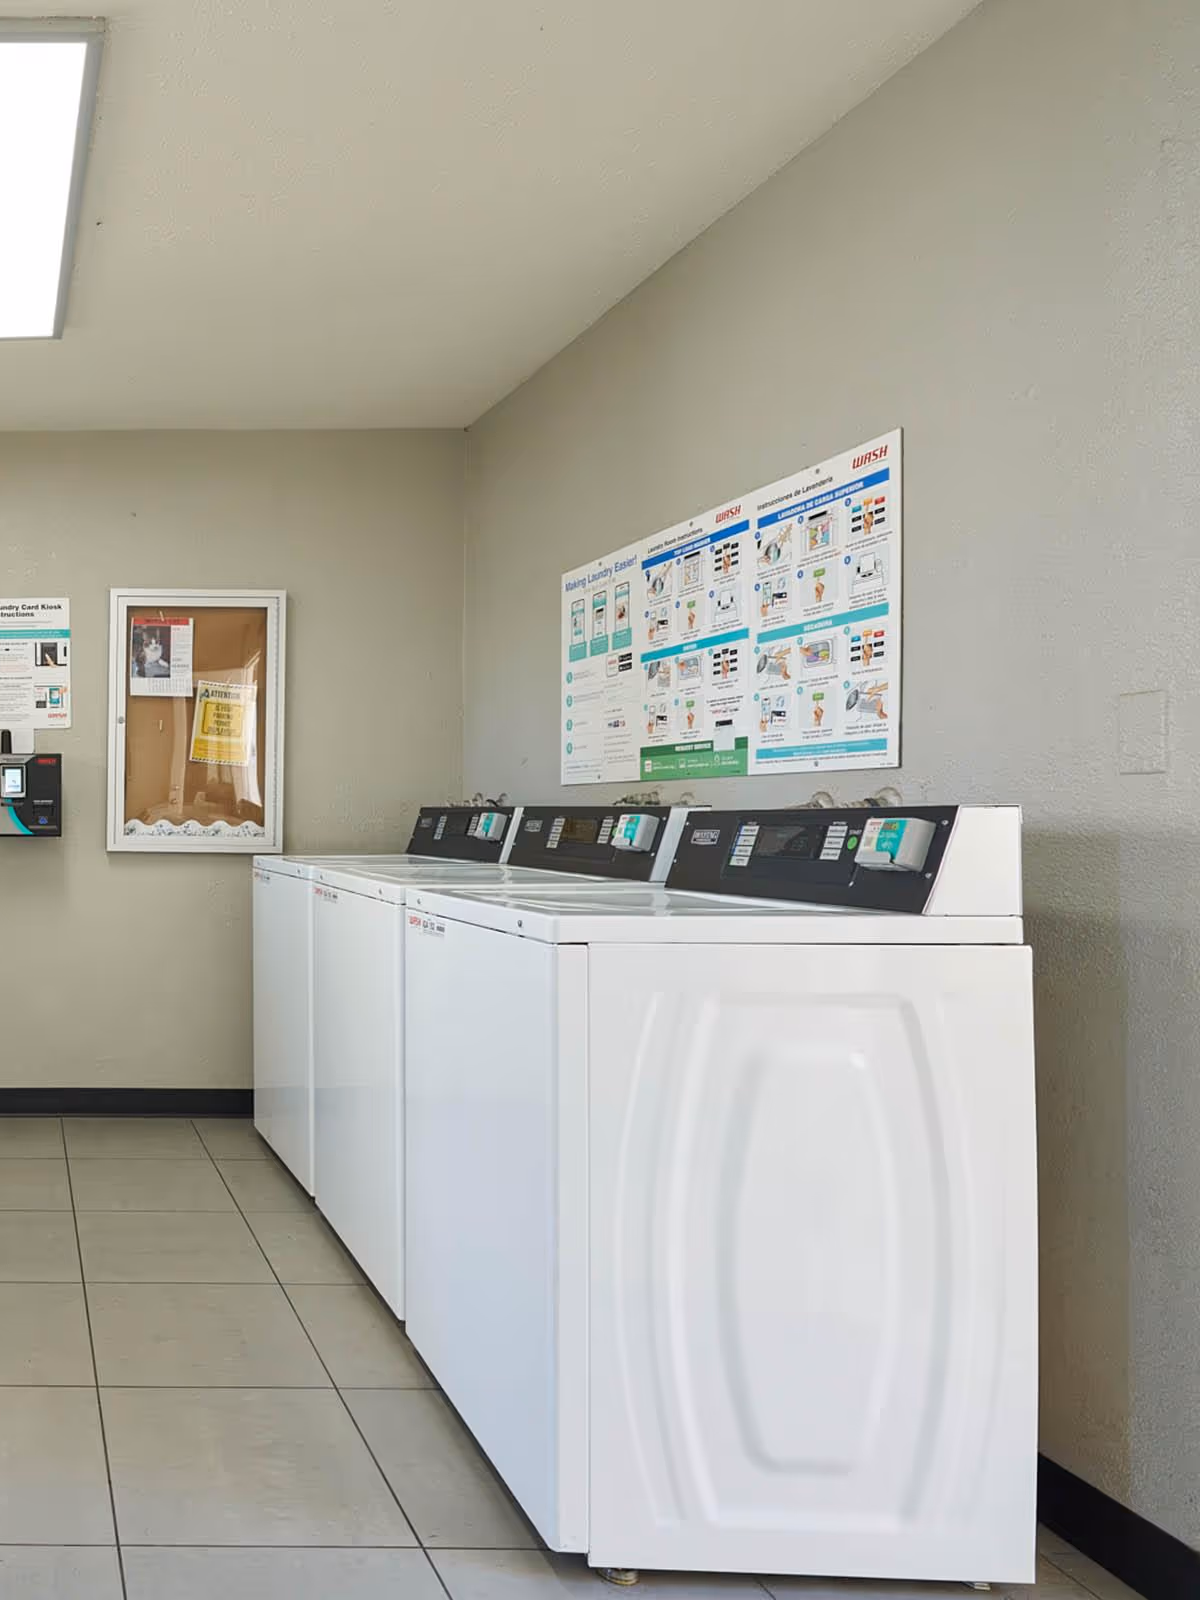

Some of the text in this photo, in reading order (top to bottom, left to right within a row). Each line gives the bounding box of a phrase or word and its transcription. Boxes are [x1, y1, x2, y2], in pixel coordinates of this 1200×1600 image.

[852, 445, 888, 469] WASH
[715, 505, 742, 523] WASH
[565, 554, 637, 592] Making Laundry Easier!
